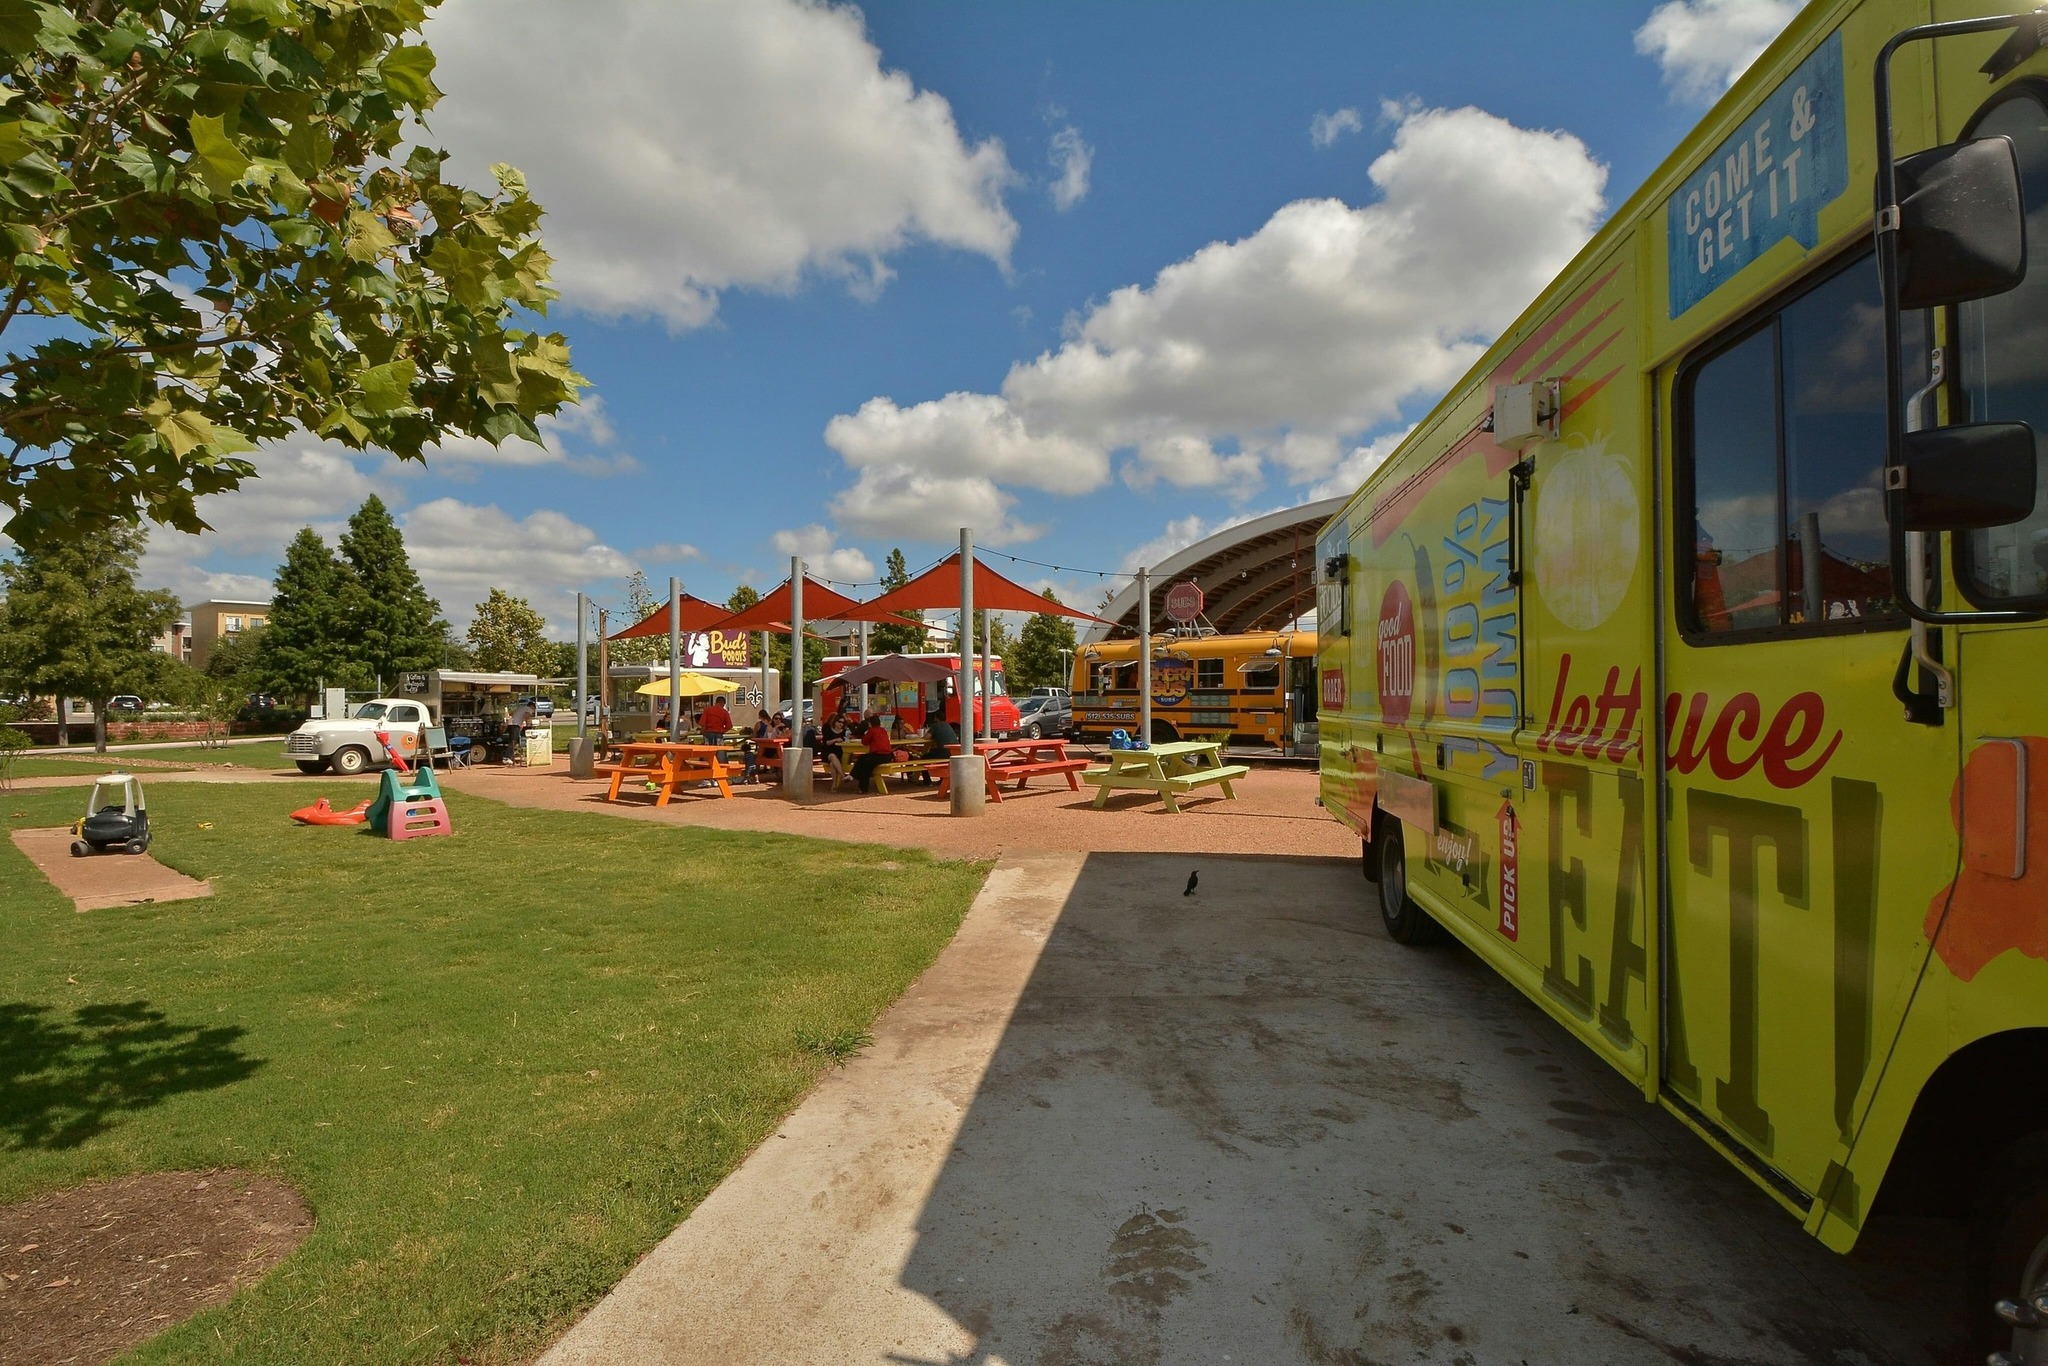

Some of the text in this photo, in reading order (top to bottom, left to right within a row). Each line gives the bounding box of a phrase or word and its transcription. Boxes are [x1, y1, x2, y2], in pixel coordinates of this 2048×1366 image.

[1685, 85, 1816, 236] COME &
[1697, 147, 1802, 274] GET IT
[1170, 596, 1196, 609] SUBS
[1378, 602, 1402, 650] good
[709, 630, 747, 654] Bud's
[1382, 634, 1412, 697] FOOD
[1443, 502, 1480, 769] 100%
[1480, 496, 1519, 780] YUMMY
[1085, 712, 1135, 720] (512) 535-SUBS
[1150, 680, 1186, 698] BUS
[1536, 653, 1844, 790] lettuce
[1437, 833, 1473, 872] enjoy!
[1503, 864, 1515, 932] PICK
